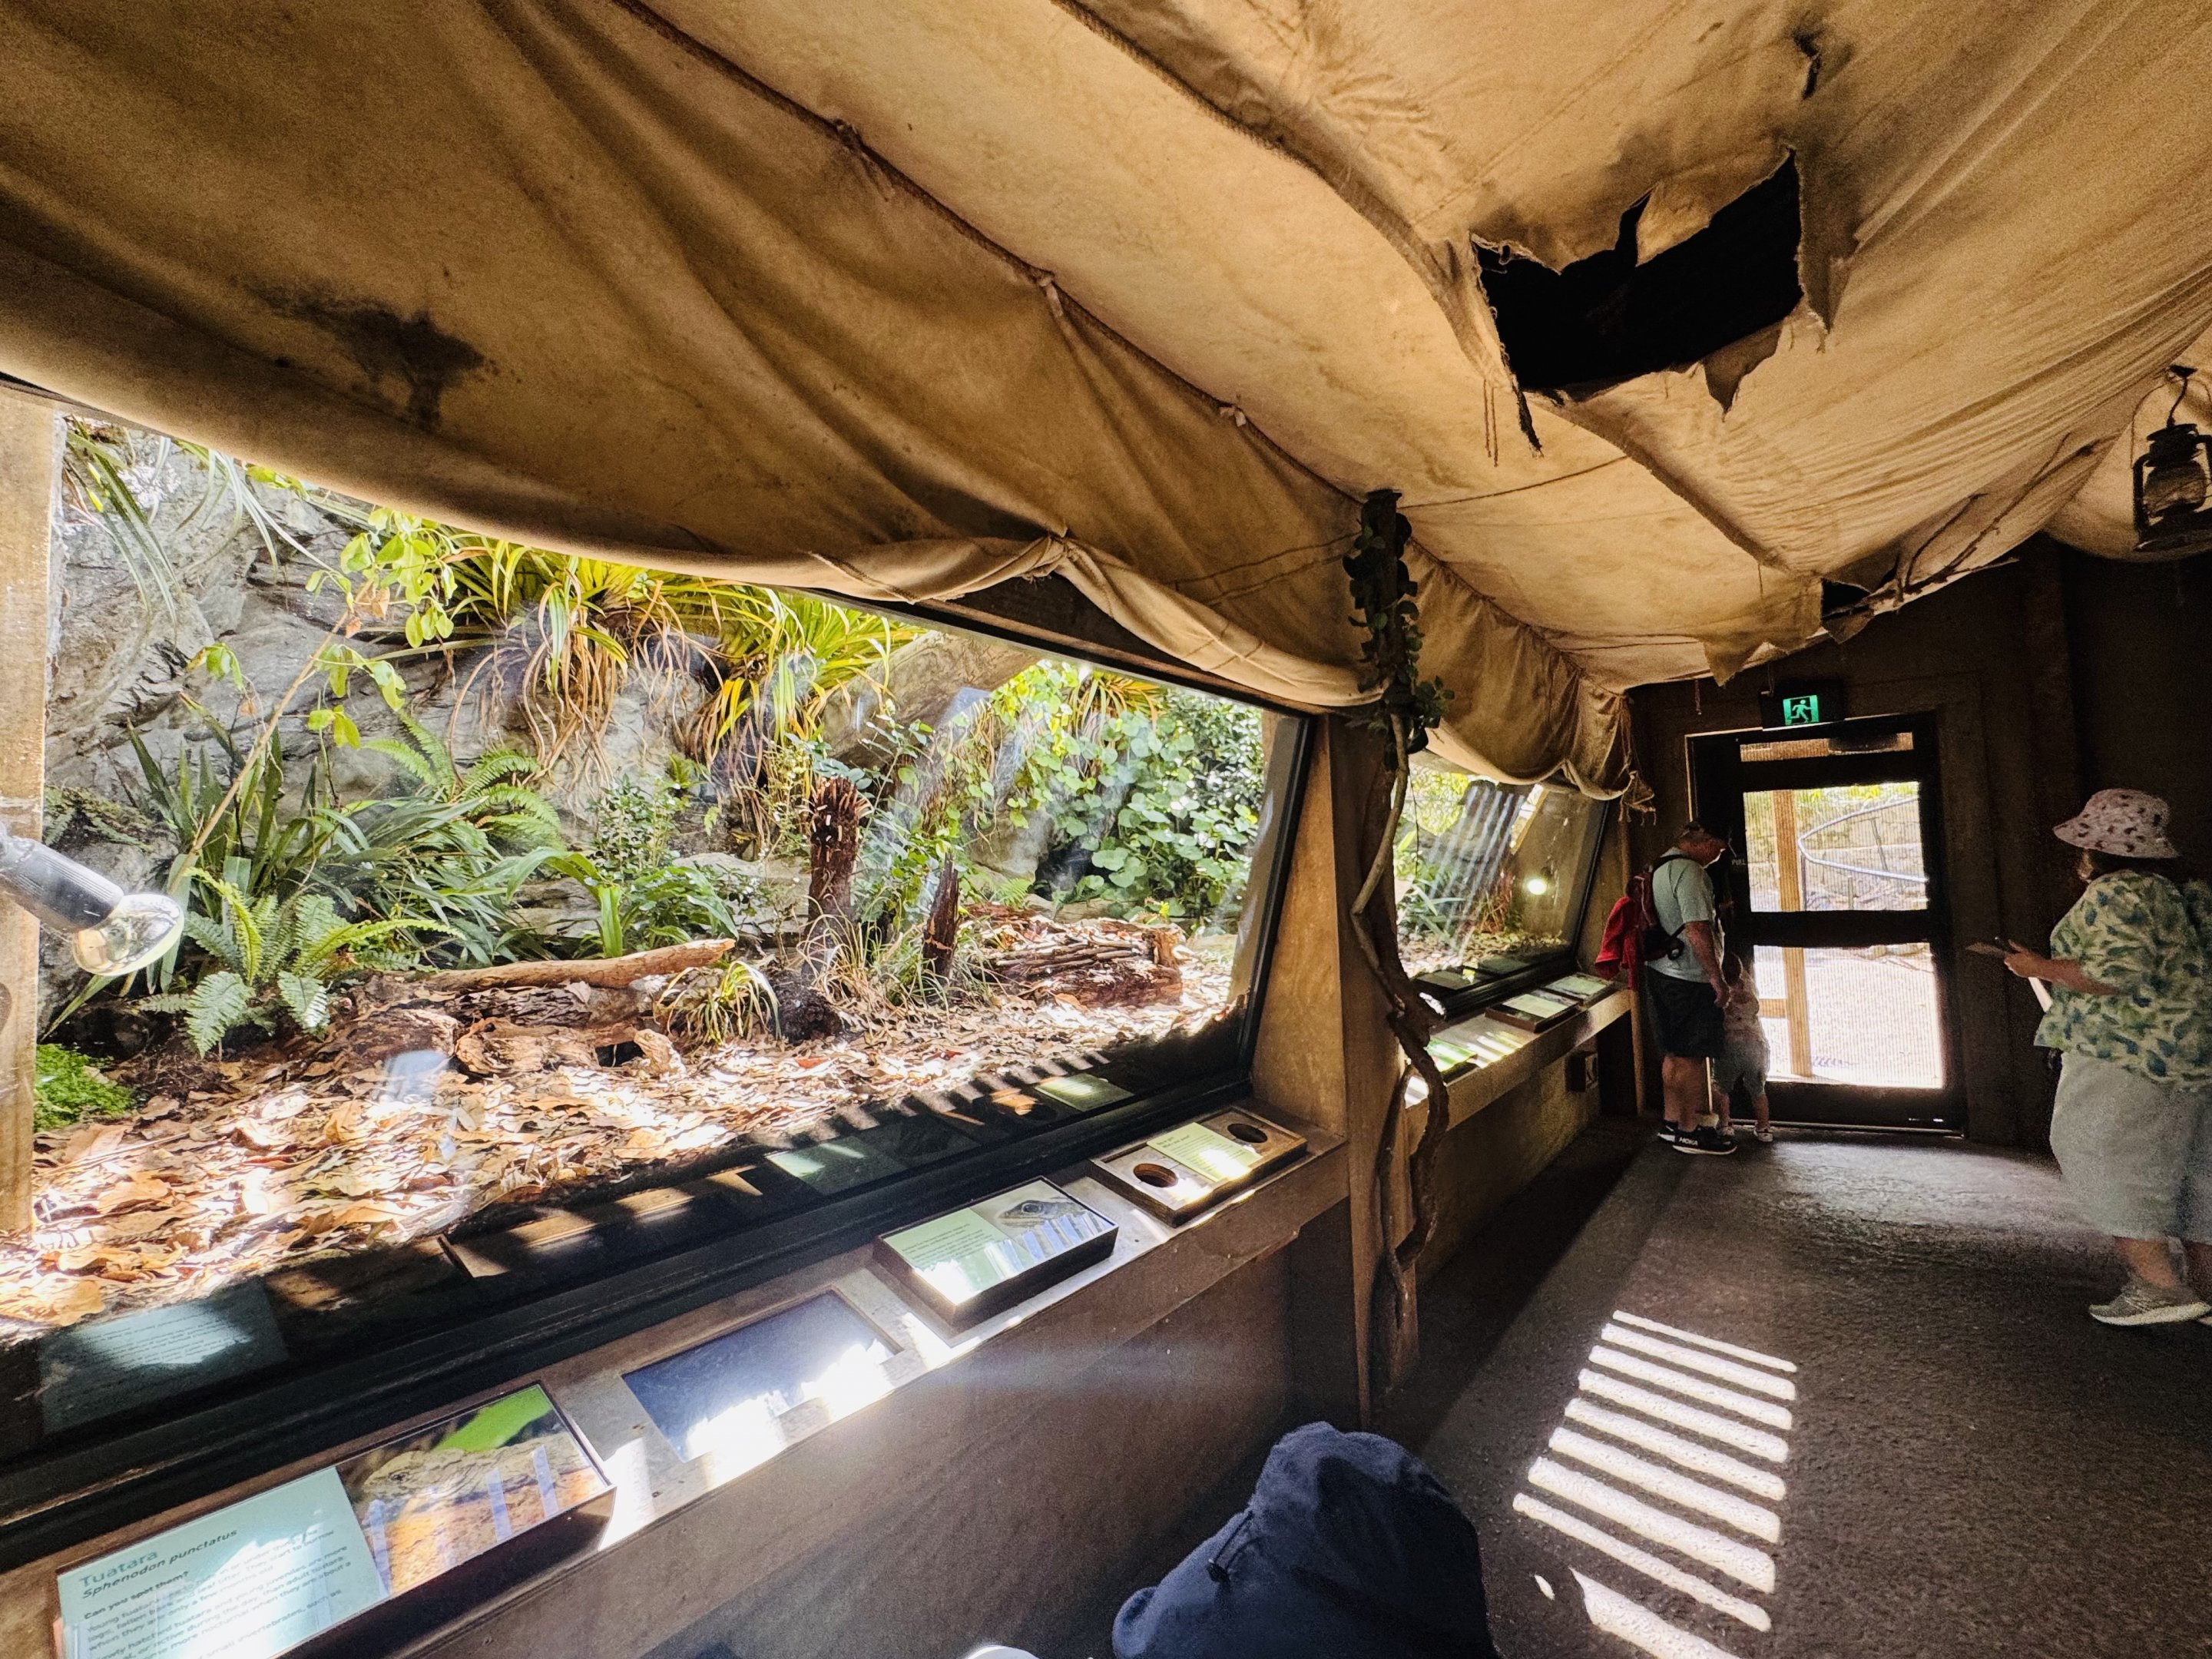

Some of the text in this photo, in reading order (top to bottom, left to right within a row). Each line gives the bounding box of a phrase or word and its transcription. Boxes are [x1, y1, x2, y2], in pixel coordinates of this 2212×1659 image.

[81, 1552, 157, 1587] Tuatara
[82, 1530, 237, 1598] Sphenodon punctatus
[174, 1608, 211, 1628] tuatara
[214, 1598, 233, 1610] and
[236, 1584, 263, 1601] young
[267, 1565, 306, 1587] juveniles
[308, 1558, 321, 1567] are
[324, 1547, 347, 1559] more
[84, 1571, 189, 1619] Can you spot them?
[137, 1645, 149, 1654] or
[187, 1614, 220, 1632] during
[223, 1604, 239, 1615] the
[263, 1584, 284, 1597] than
[286, 1571, 310, 1586] adult
[171, 1634, 197, 1650] more
[201, 1608, 249, 1635] nocturnal
[253, 1596, 277, 1611] when
[280, 1586, 300, 1598] they
[301, 1578, 316, 1588] are
[177, 1591, 195, 1603] and
[197, 1582, 215, 1594] leaf
[307, 1595, 327, 1609] such
[329, 1588, 342, 1598] as
[88, 1634, 119, 1652] when
[122, 1623, 144, 1637] they
[167, 1604, 189, 1617] only
[200, 1591, 217, 1602] few
[88, 1616, 119, 1633] Young
